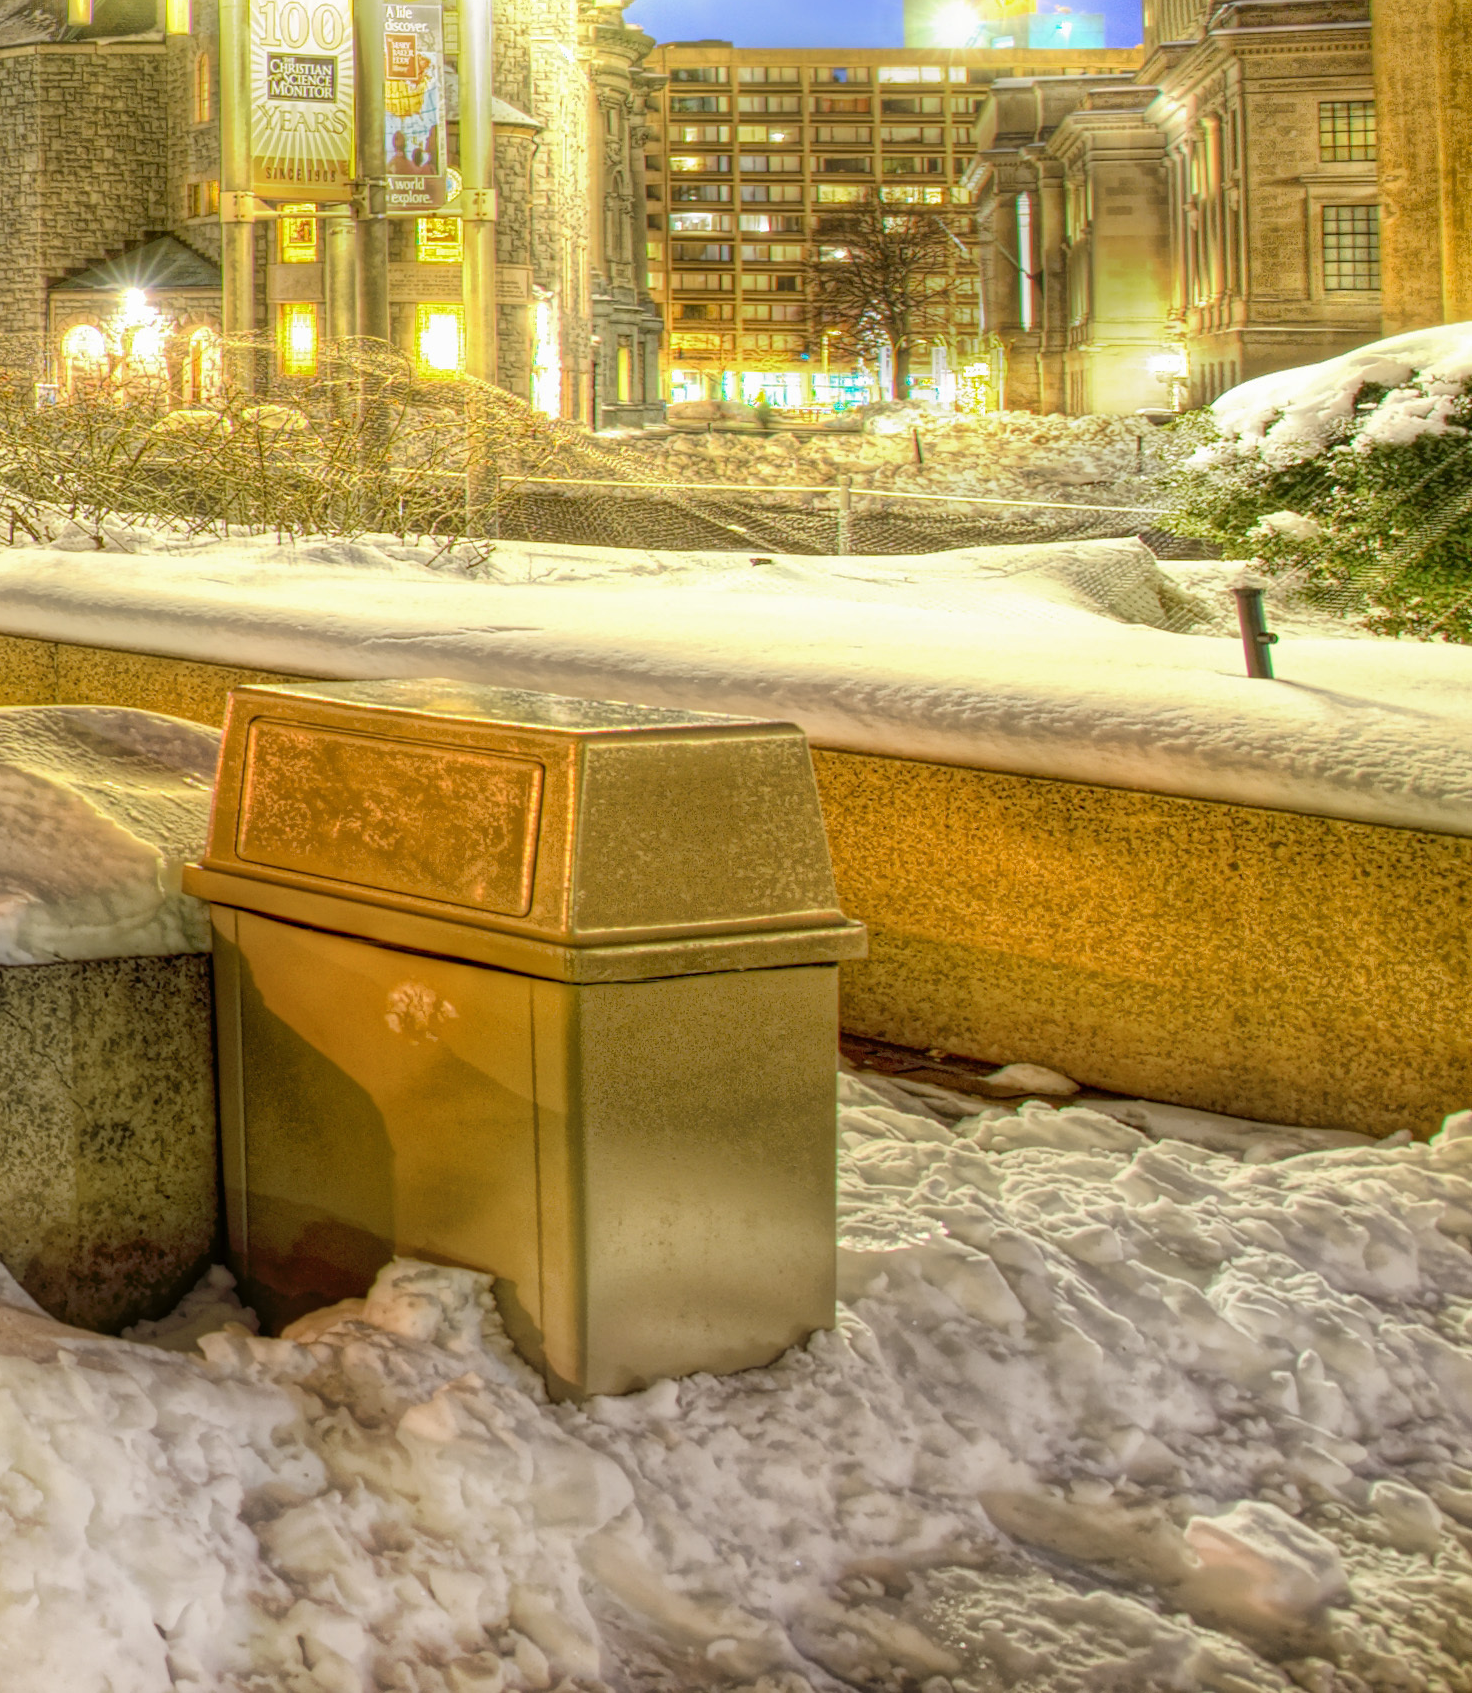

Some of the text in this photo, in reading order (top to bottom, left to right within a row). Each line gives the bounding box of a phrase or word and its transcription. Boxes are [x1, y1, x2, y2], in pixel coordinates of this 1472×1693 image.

[386, 6, 413, 19] A life
[259, 0, 344, 51] 100
[385, 19, 430, 32] discover.
[270, 58, 333, 75] CHRISTIAN
[282, 72, 333, 87] SCIENCE
[271, 81, 334, 99] MONITOR
[256, 105, 347, 135] YEARS
[266, 167, 302, 182] SINCE
[386, 177, 425, 190] A world
[391, 190, 433, 206] explore.
